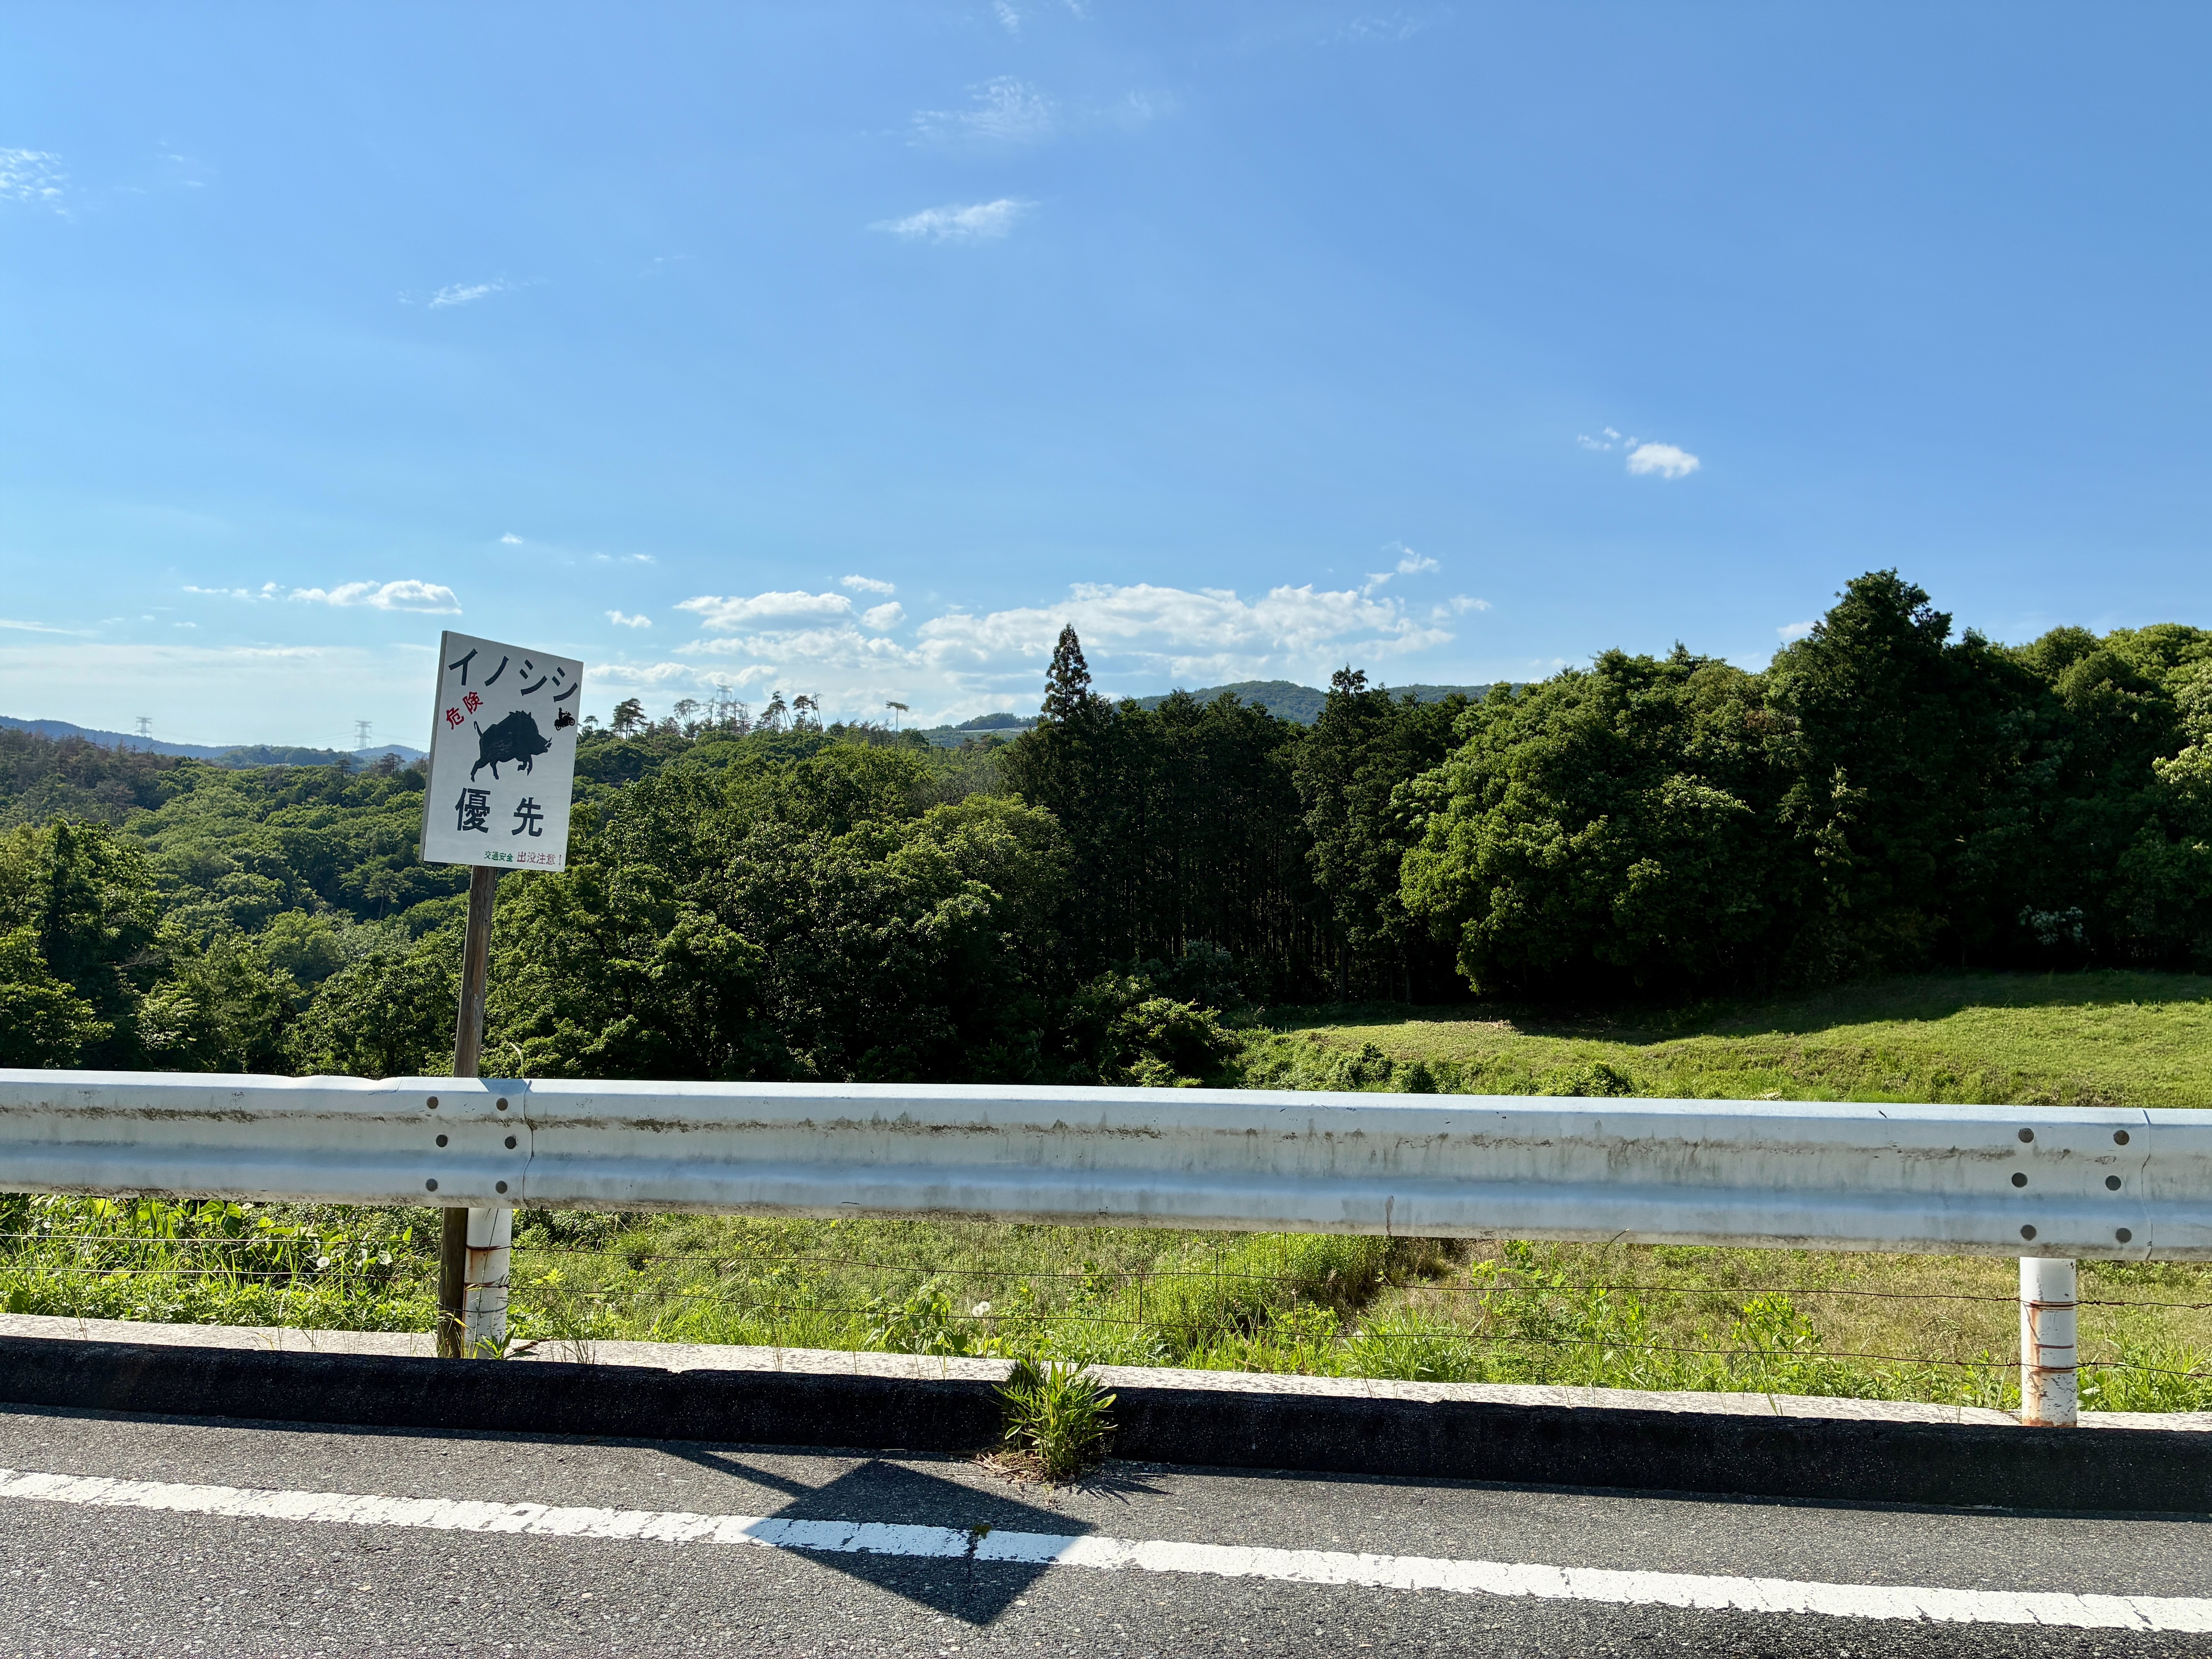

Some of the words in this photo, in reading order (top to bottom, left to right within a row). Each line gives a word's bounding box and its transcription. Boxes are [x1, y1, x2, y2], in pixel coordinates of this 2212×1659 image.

[448, 648, 578, 702] イノシシ
[446, 691, 483, 730] 危険
[455, 788, 544, 837] 優先
[484, 851, 514, 862] 交通安全
